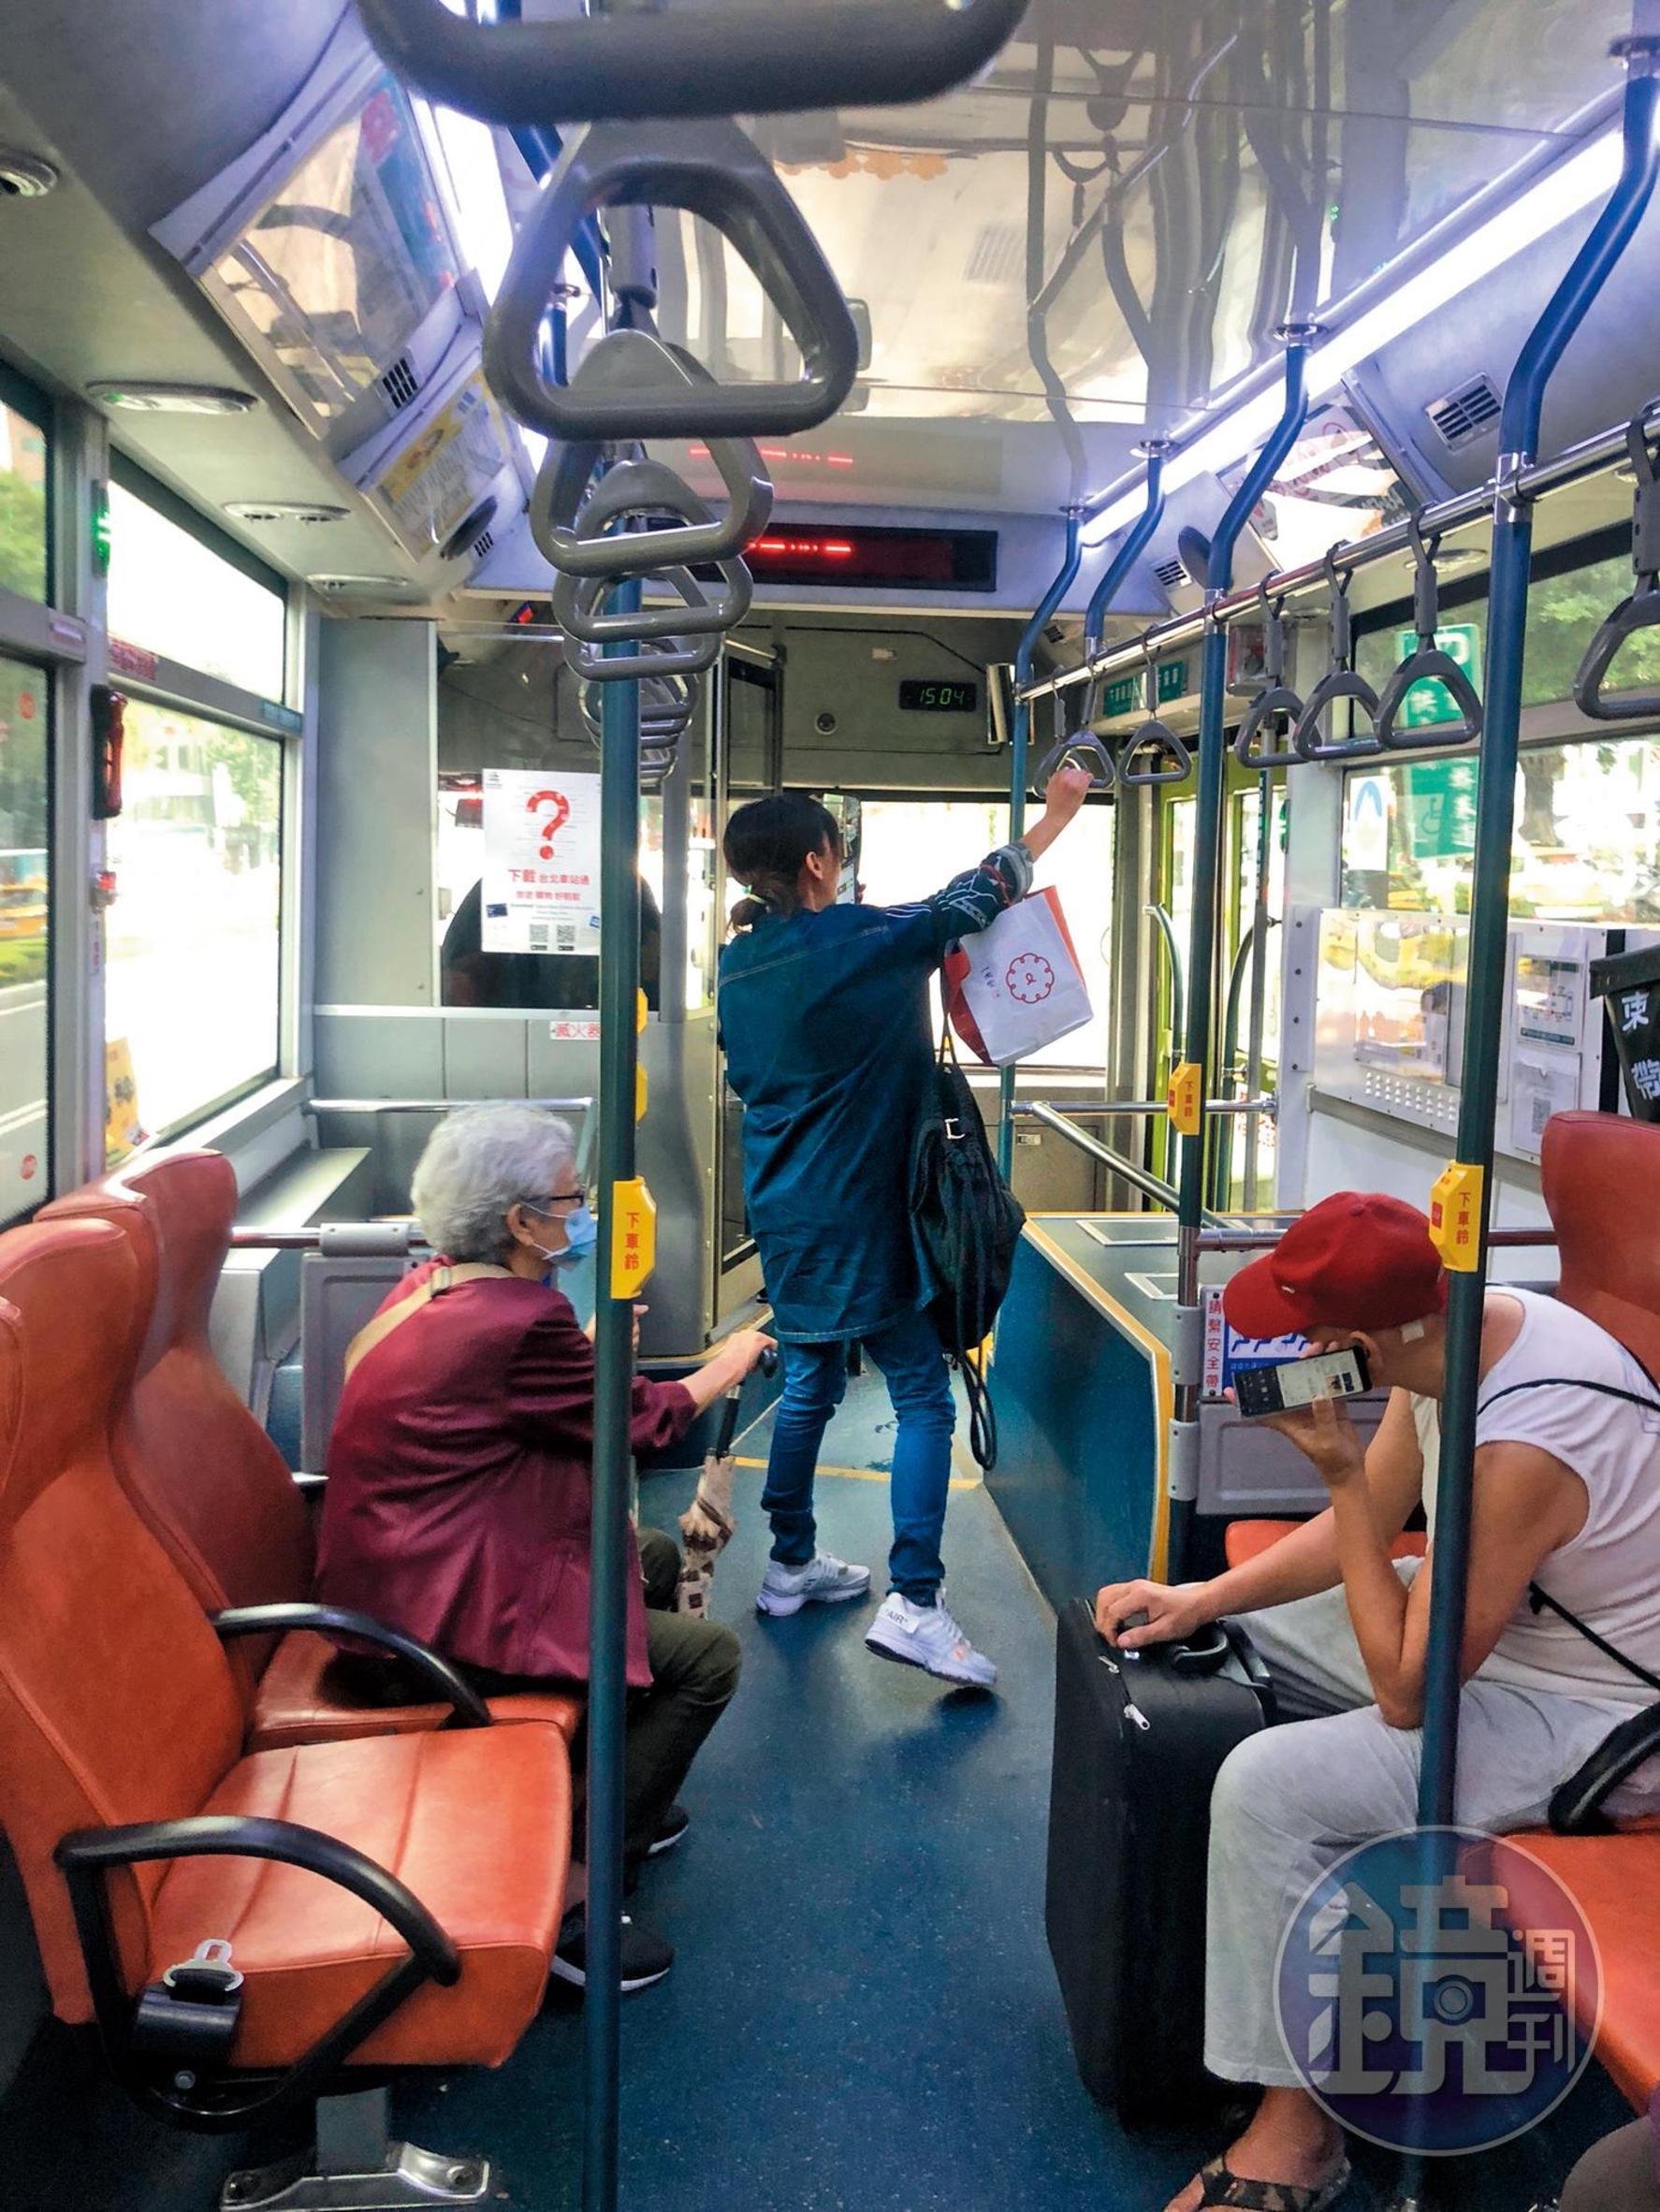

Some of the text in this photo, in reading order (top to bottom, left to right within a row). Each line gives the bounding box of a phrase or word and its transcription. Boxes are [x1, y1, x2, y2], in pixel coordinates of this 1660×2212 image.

[919, 687, 965, 706] 1504
[624, 1212, 640, 1271] 下車鈴
[1457, 1191, 1472, 1245] 下車鈴
